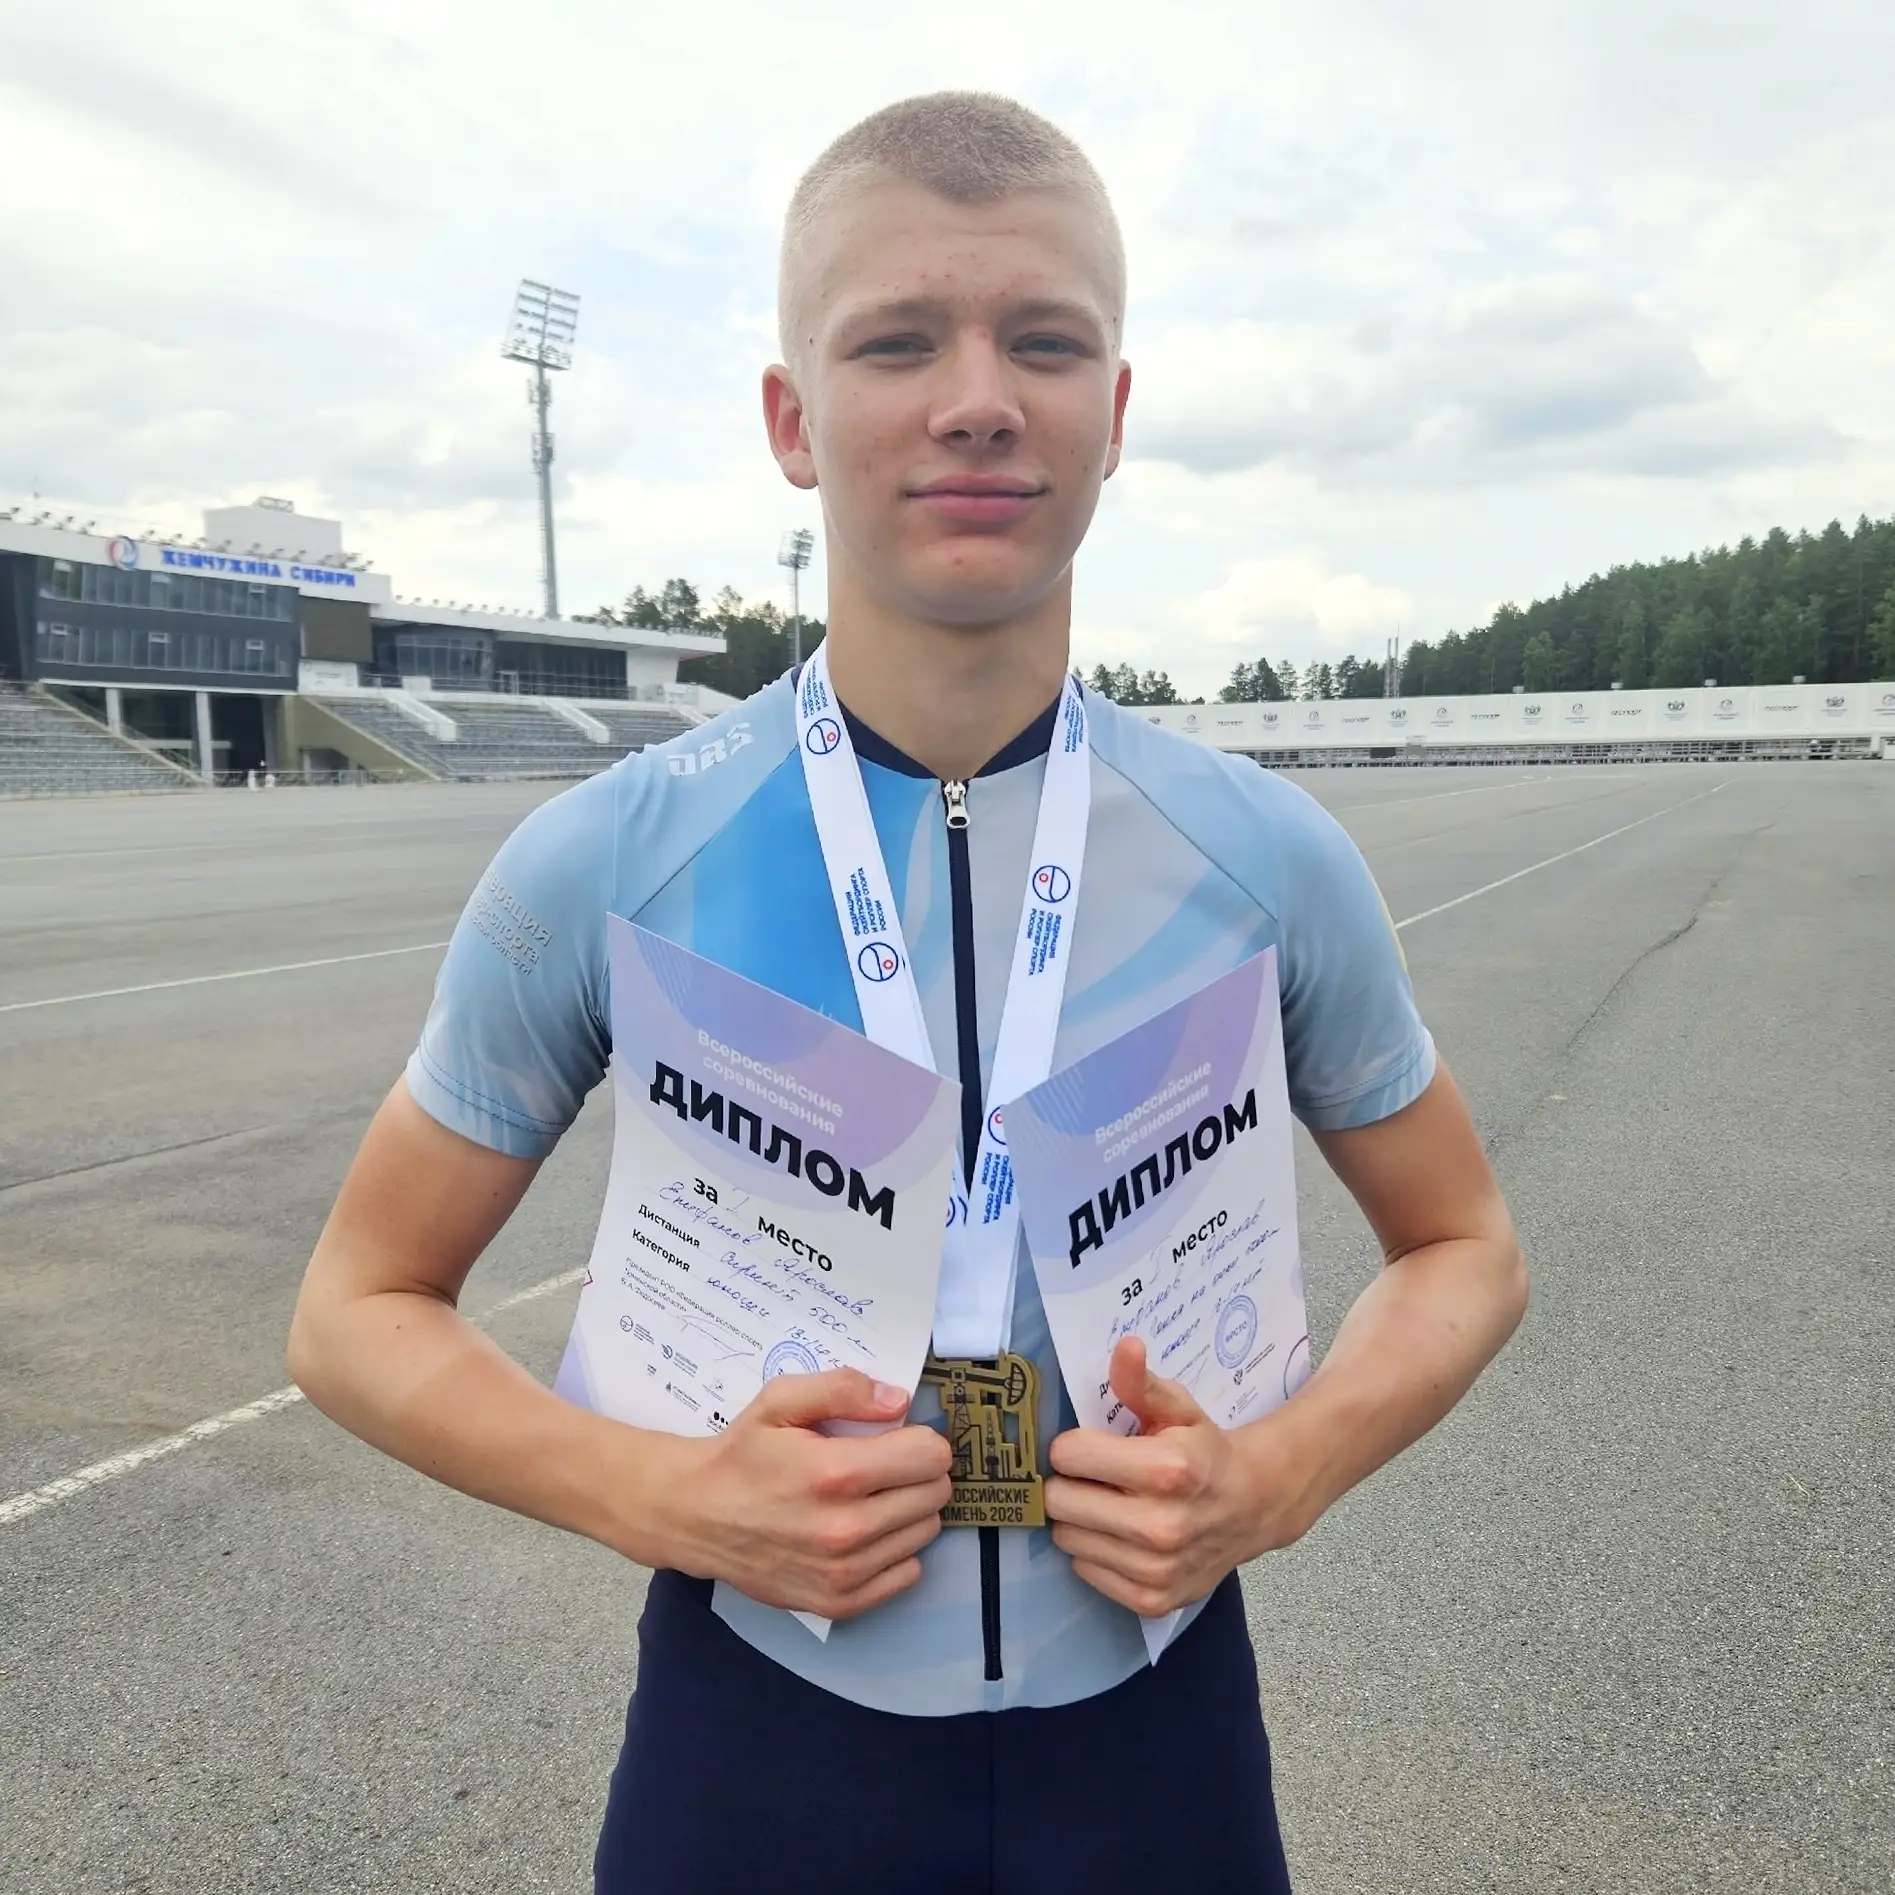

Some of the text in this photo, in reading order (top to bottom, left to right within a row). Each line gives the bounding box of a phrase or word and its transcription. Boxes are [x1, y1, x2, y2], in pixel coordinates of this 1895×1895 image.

[161, 549, 356, 588] ЖЕМЧУЖИНА СИБИРИ
[858, 867, 869, 895] СПОРТА
[874, 900, 886, 931] РОССИИ
[698, 1028, 844, 1119] Всероссийские
[702, 1056, 836, 1137] соревнования
[1094, 1062, 1213, 1146] Всероссийские
[649, 1060, 895, 1231] ДИПЛОМ
[1103, 1084, 1210, 1163] соревнования
[1068, 1088, 1258, 1269] ДИПЛОМ
[632, 1228, 690, 1272] Категория
[638, 1204, 700, 1249] Дистанция
[693, 1177, 718, 1205] за
[758, 1216, 833, 1272] место
[1121, 1277, 1143, 1306] за
[1172, 1210, 1228, 1263] место
[808, 1306, 847, 1333] 500
[939, 1506, 1023, 1523] ЮМЕНЬ 2026
[953, 1486, 1030, 1504] ОССИЙСКИЕ
